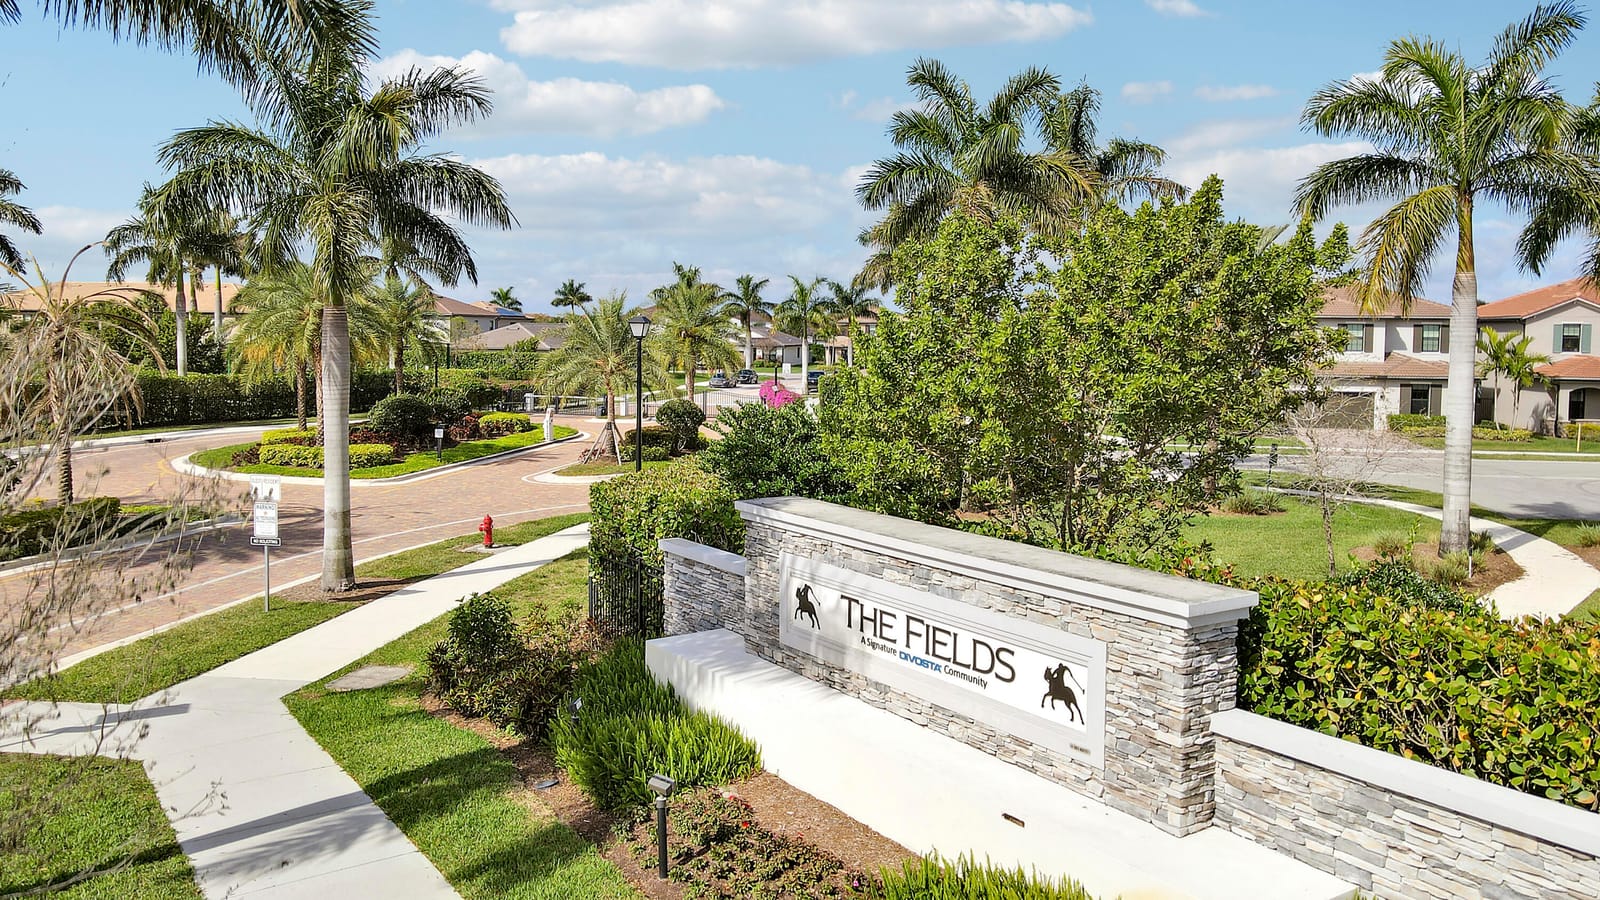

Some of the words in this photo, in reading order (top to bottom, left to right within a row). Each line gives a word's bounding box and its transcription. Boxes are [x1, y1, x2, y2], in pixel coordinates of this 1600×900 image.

[840, 594, 897, 644] THE
[905, 614, 1016, 684] FIELDS
[860, 636, 866, 645] A
[866, 637, 897, 656] Signature
[944, 664, 988, 690] Community
